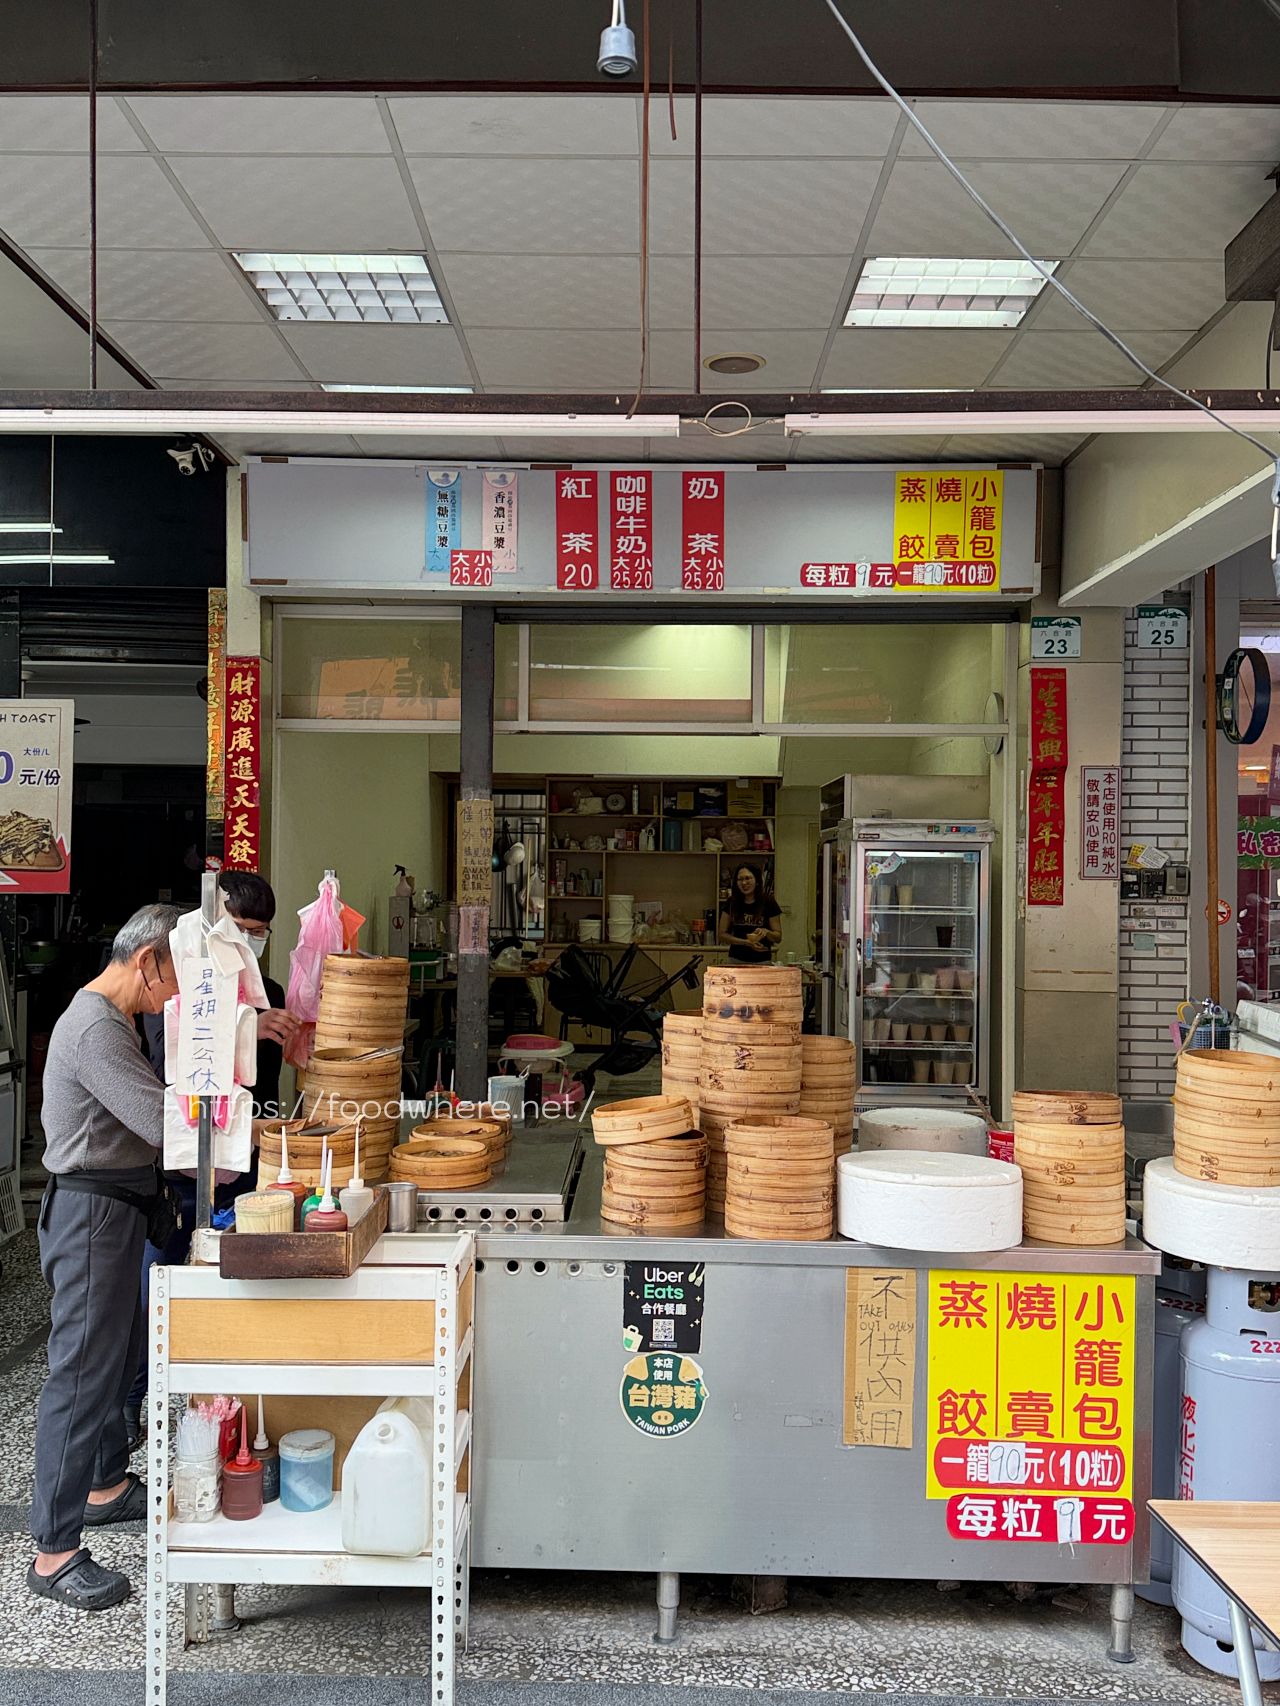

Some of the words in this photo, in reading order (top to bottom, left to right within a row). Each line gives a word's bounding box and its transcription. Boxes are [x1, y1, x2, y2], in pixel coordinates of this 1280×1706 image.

[437, 490, 449, 548] 無糖豆漿
[494, 491, 506, 549] 香濃豆漿
[561, 477, 593, 555] 紅茶
[615, 476, 647, 554] 咖啡牛奶
[688, 477, 719, 555] 奶茶
[899, 477, 926, 559] 蒸餃
[935, 477, 962, 559] 燒賣
[970, 477, 997, 558] 小籠包
[452, 552, 470, 567] 大
[474, 552, 492, 567] 小
[613, 557, 630, 570] 大
[634, 556, 651, 570] 小
[684, 557, 701, 570] 大
[706, 556, 723, 570] 小
[452, 567, 470, 585] 25
[473, 567, 492, 586] 20
[564, 563, 593, 587] 20
[613, 571, 631, 589] 25
[634, 571, 652, 589] 20
[684, 571, 702, 589] 25
[706, 571, 723, 590] 20
[1044, 639, 1068, 655] 23
[1151, 630, 1175, 645] 25
[11, 713, 56, 723] TOAST
[23, 747, 50, 756] 大份/L
[19, 769, 61, 785] 元/份
[228, 671, 257, 865] 財源廣進天天發
[1086, 779, 1100, 868] 敬請安心使用
[1102, 772, 1116, 875] 本店使用RO純水
[463, 866, 489, 874] AWAY
[186, 968, 220, 1092] 星期二公休
[643, 1267, 685, 1283] Uber
[644, 1284, 685, 1300] Eats
[641, 1302, 687, 1316] 合作餐廳
[858, 1304, 884, 1319] TAKE
[860, 1320, 880, 1332] OUT
[653, 1357, 674, 1369] 本店
[937, 1280, 988, 1437] 蒸餃
[1006, 1282, 1057, 1439] 燒賣
[1072, 1284, 1124, 1441] 小籠包
[653, 1370, 673, 1381] 使用
[628, 1384, 697, 1409] 台灣豬
[635, 1416, 666, 1435] TAIWAN
[666, 1418, 691, 1435] PORK
